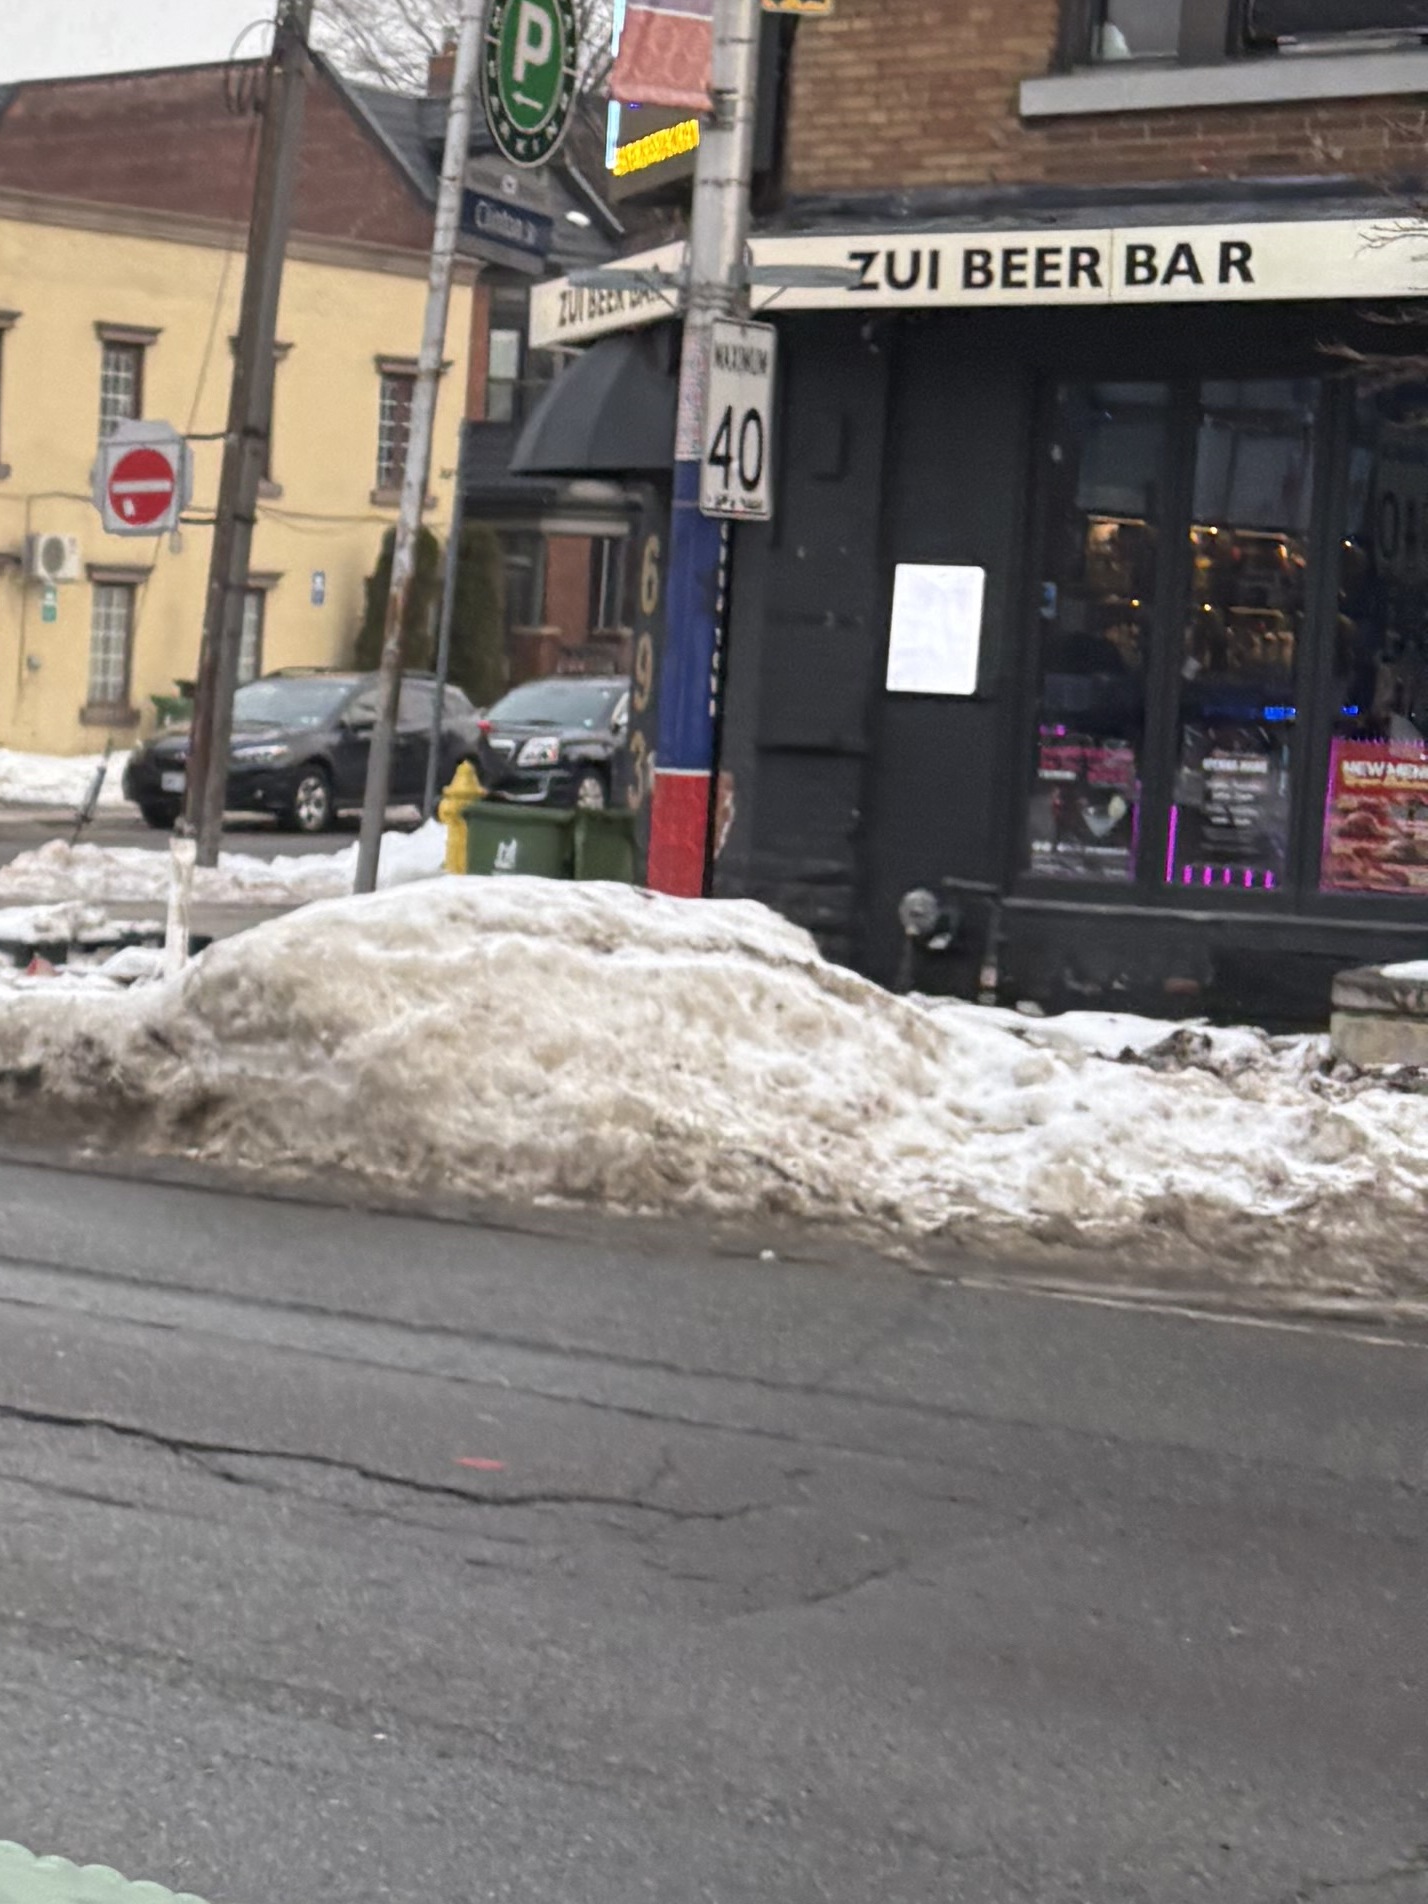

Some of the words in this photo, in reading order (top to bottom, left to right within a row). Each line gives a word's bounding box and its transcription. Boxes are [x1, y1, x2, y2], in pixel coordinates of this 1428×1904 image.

[512, 0, 553, 83] P
[846, 249, 940, 291] ZUI
[962, 245, 1103, 290] BEER
[1124, 240, 1255, 287] BAR
[708, 404, 764, 492] 40
